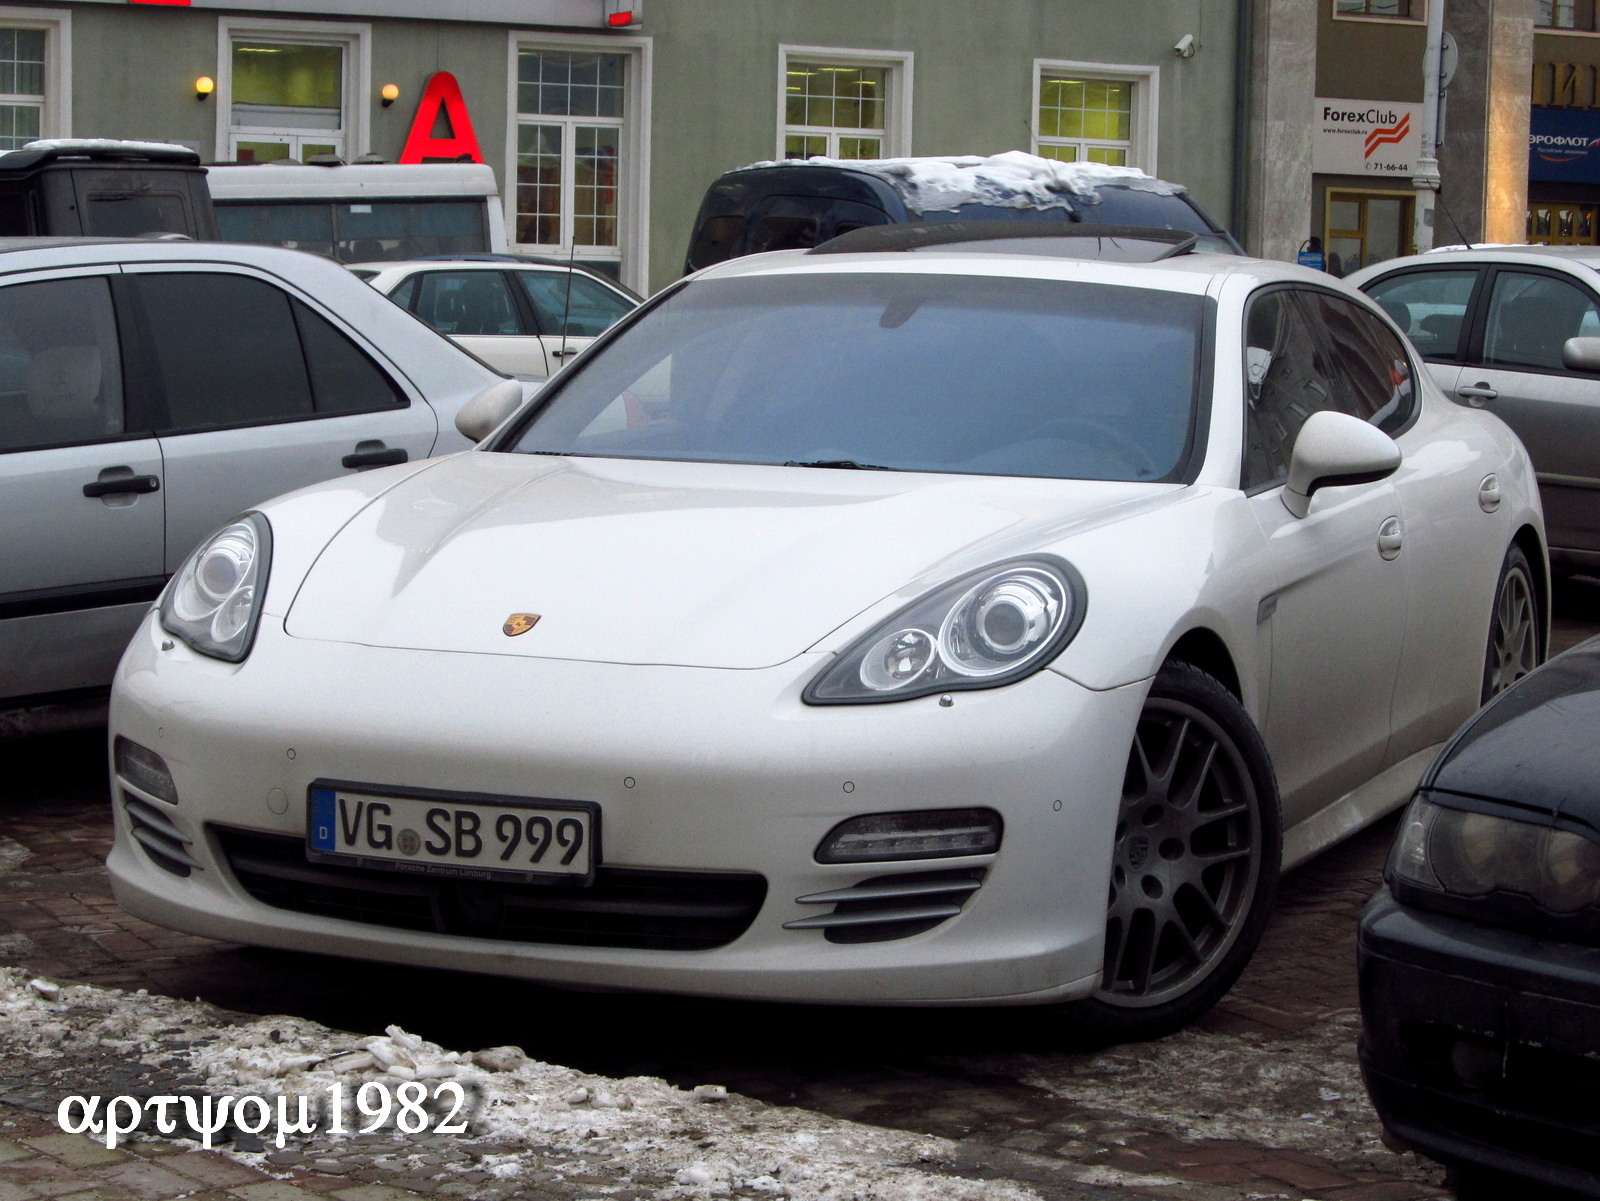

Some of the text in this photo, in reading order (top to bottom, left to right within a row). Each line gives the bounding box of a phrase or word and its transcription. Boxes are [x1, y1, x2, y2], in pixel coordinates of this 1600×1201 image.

[1323, 107, 1397, 124] ForexClub
[1322, 127, 1368, 135] www.forexclub.ru
[1528, 134, 1589, 147] ЭРОФЛОТ
[1374, 163, 1408, 171] 71-66-44
[319, 826, 328, 839] D
[338, 798, 584, 866] VG SB 999
[395, 862, 492, 880] Porsche Zentrum Limburg
